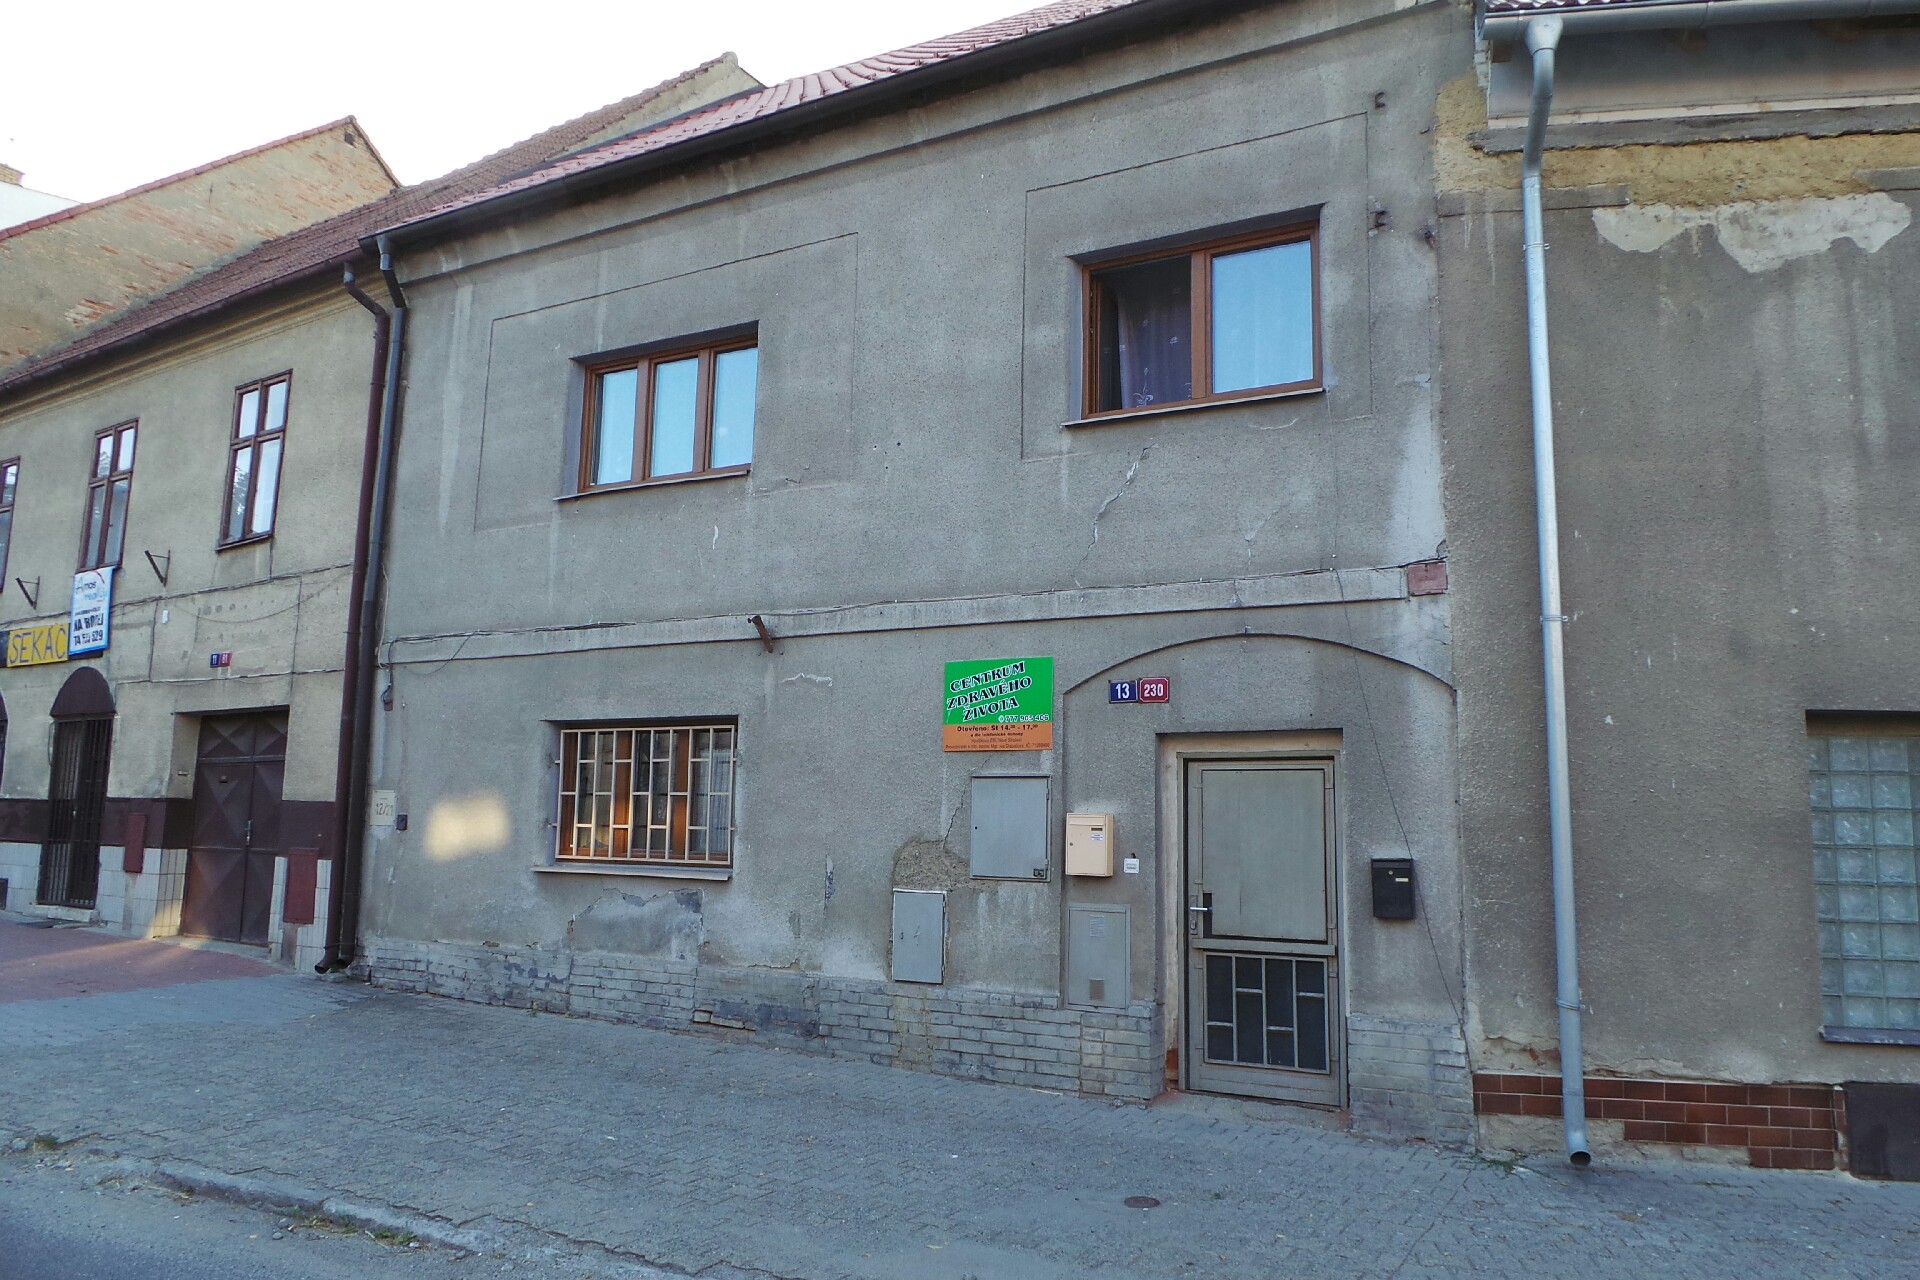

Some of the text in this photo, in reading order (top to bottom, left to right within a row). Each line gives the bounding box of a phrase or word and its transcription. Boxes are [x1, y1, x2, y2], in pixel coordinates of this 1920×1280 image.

[950, 661, 1025, 692] CENTRUM
[947, 676, 1032, 710] ZDRAVÉHO
[1116, 683, 1164, 699] 13 230
[963, 696, 1019, 722] ŽIVOTA
